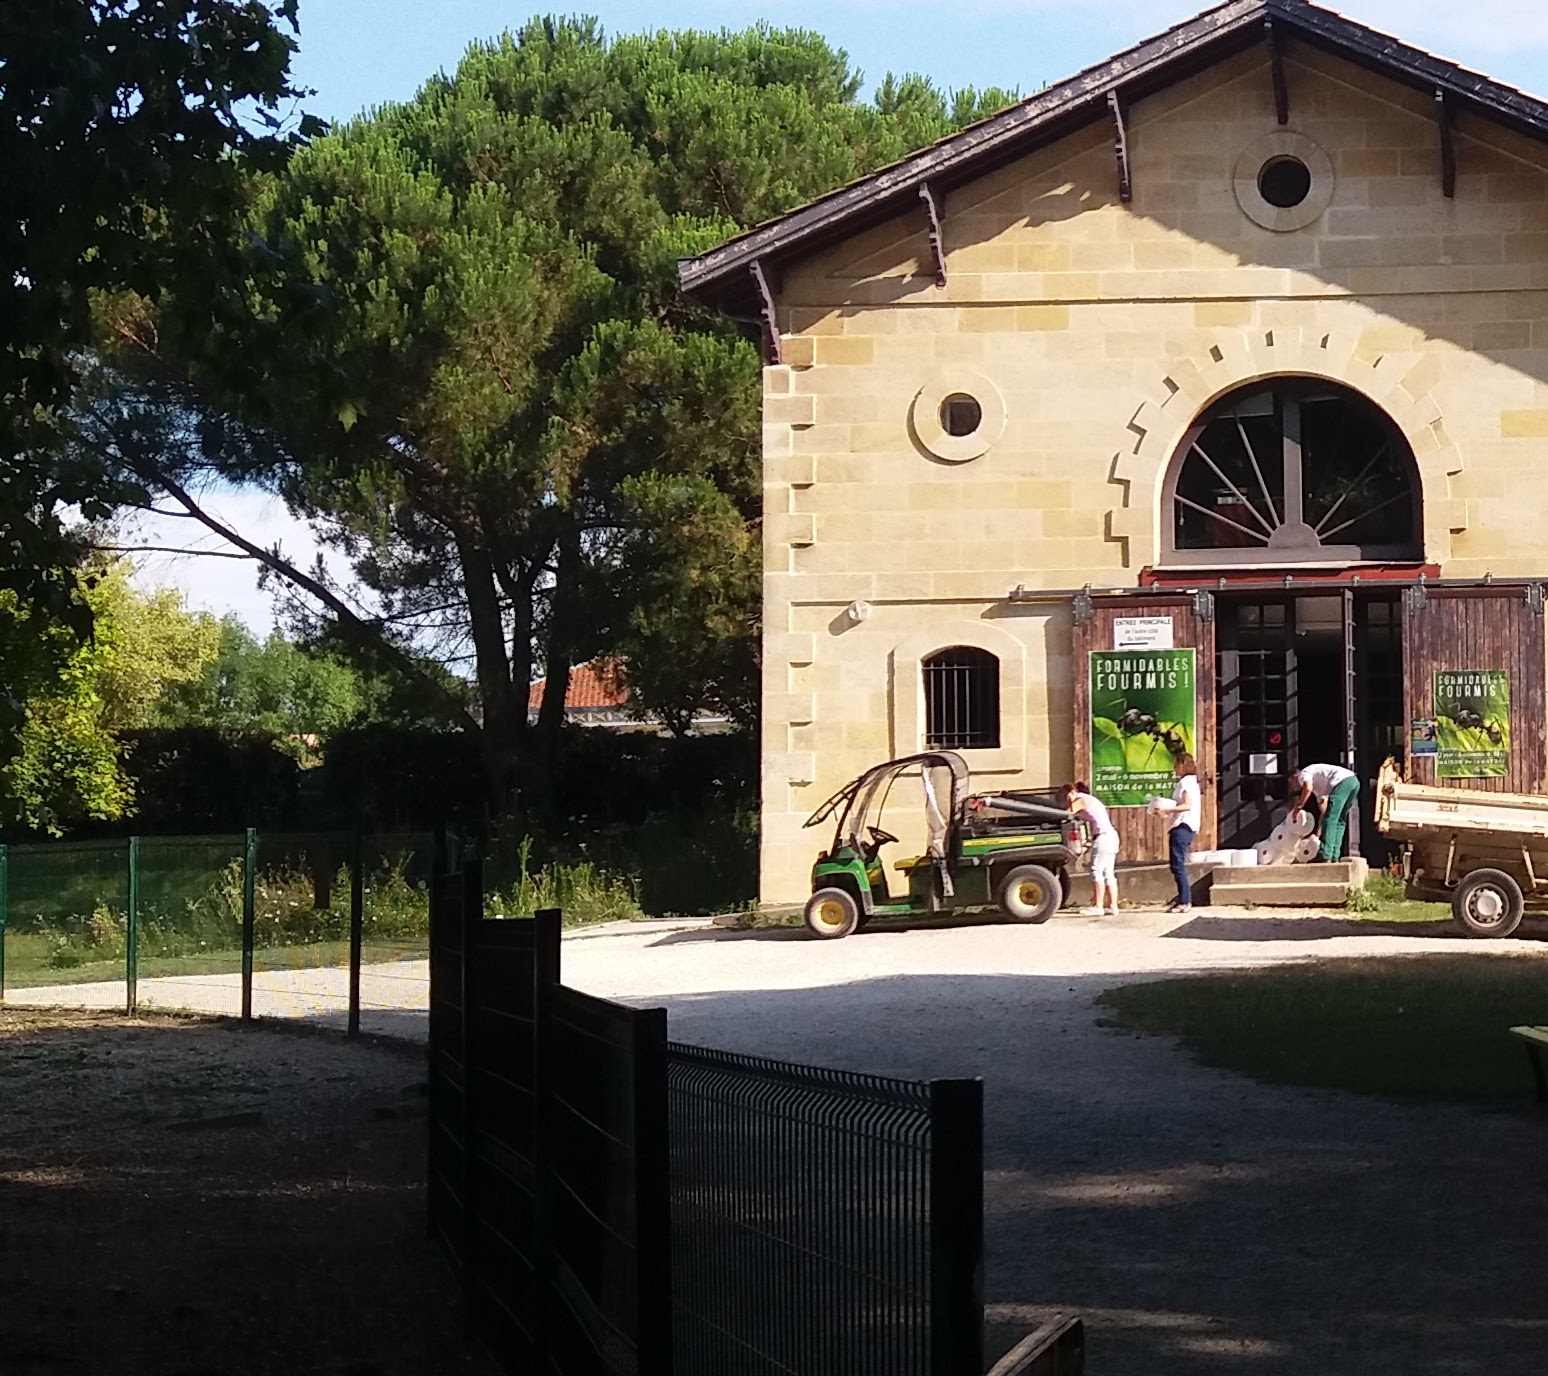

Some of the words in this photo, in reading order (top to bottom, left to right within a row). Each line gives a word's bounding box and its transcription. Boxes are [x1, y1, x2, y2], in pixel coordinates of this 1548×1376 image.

[1096, 658, 1189, 673] FORMIDABLES
[1096, 672, 1177, 690] FOURMIS
[1184, 671, 1189, 688] !
[1438, 674, 1505, 685] FORMIDABLES
[1438, 684, 1496, 698] FOURMIS
[1155, 782, 1176, 790] NAT
